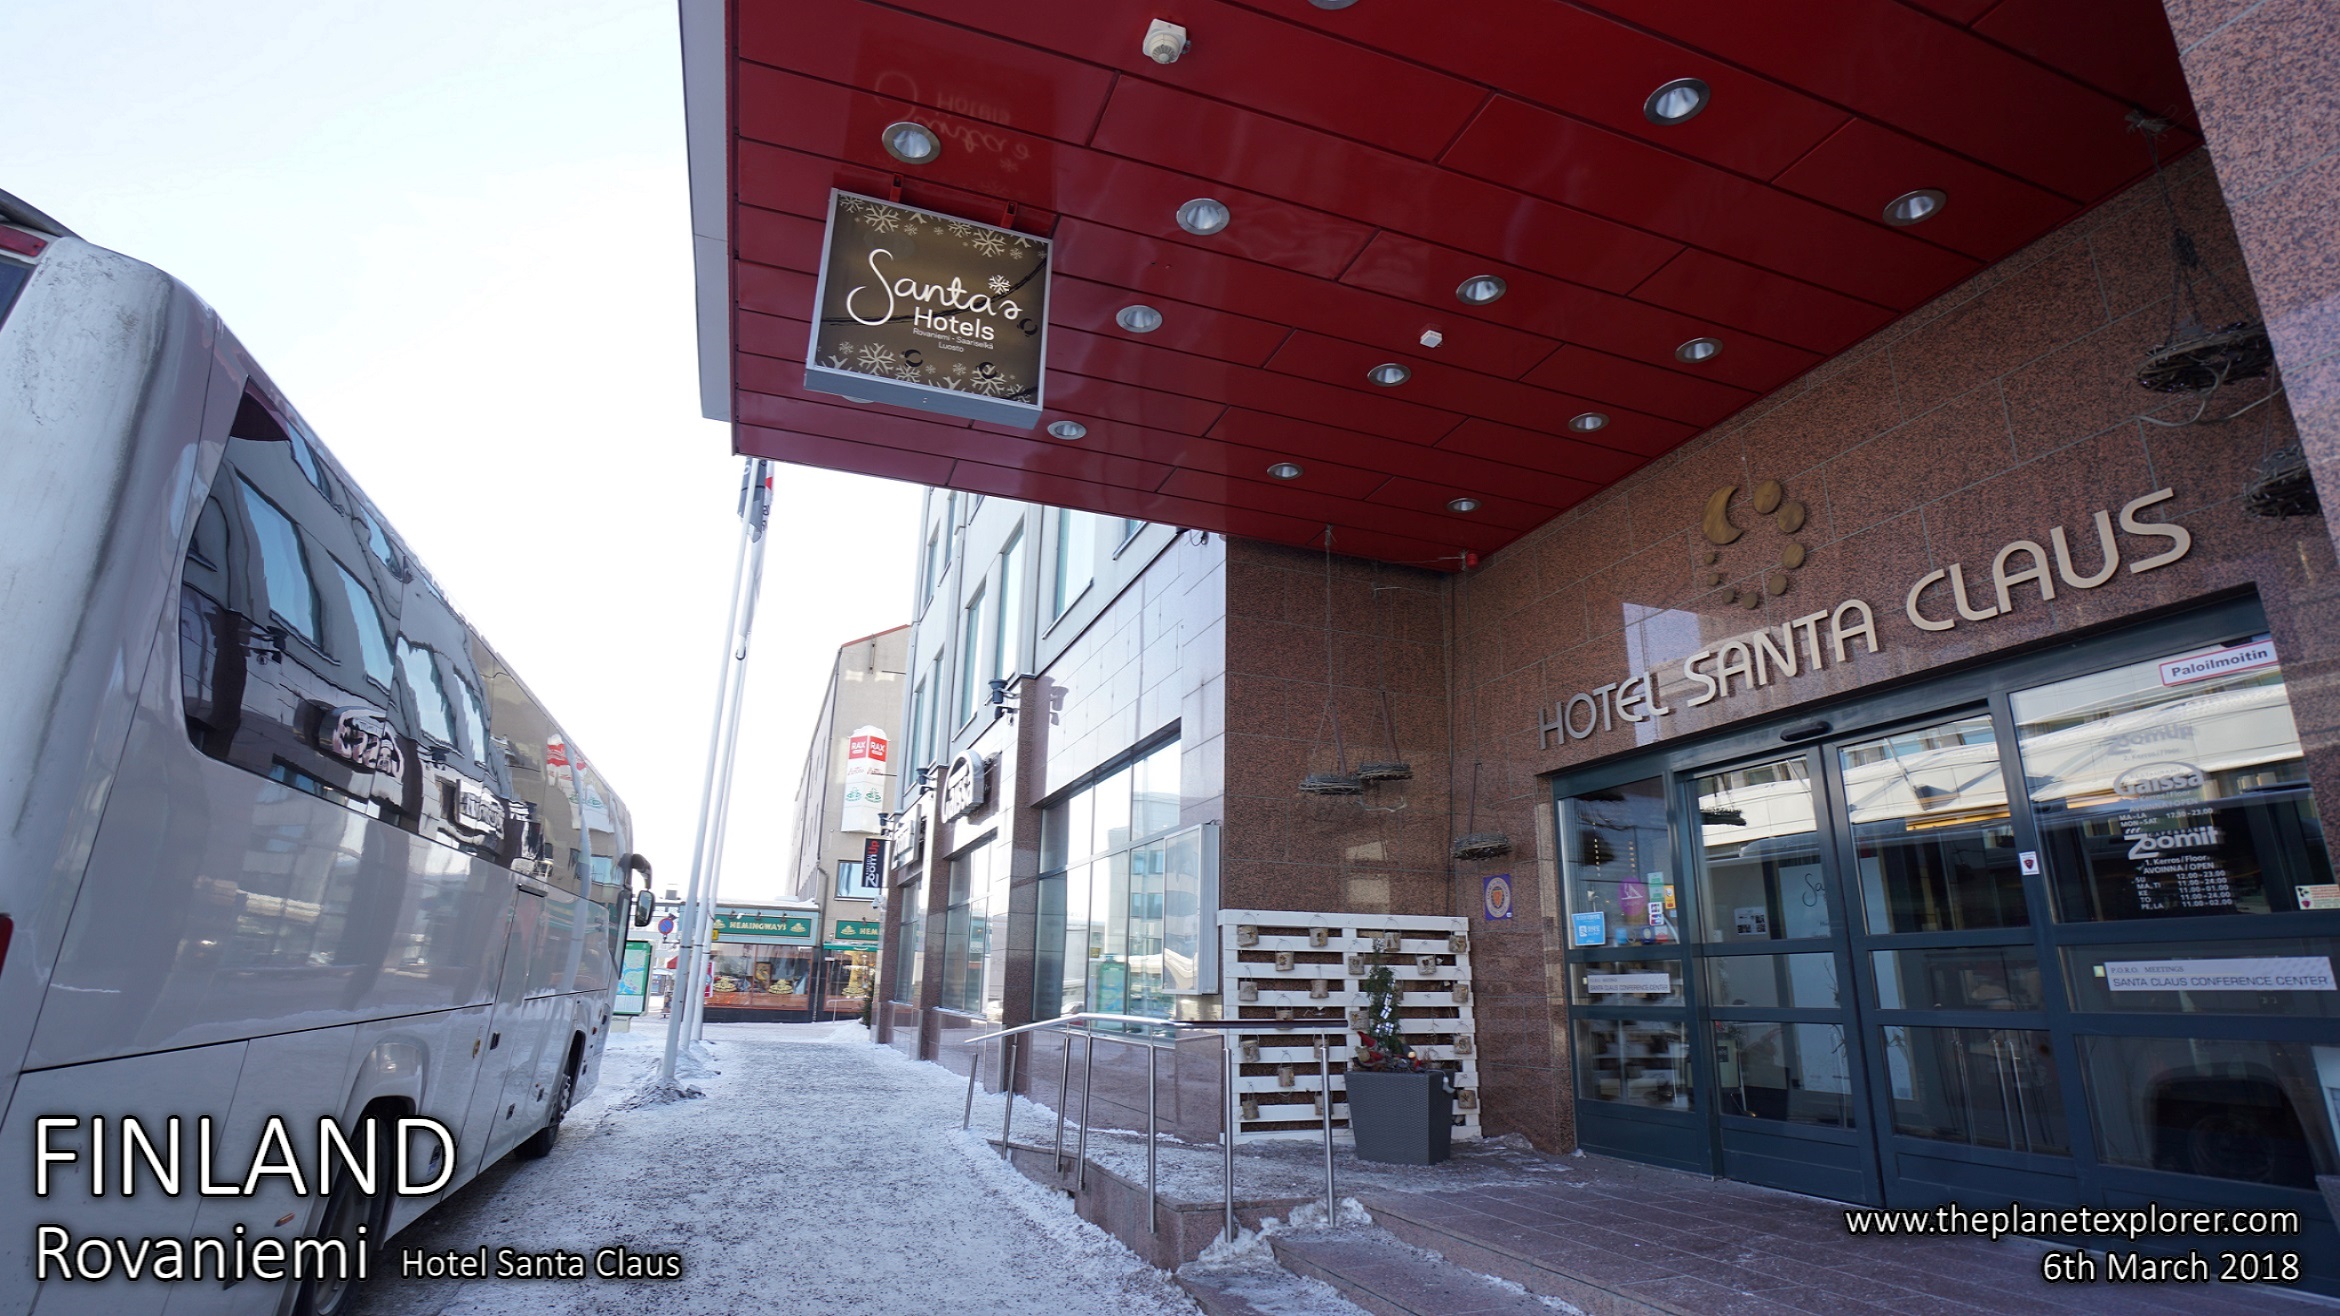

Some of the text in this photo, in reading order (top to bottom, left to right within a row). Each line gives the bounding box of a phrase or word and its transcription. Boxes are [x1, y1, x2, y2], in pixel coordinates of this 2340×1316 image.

[914, 306, 995, 341] Hotels
[913, 328, 950, 341] Rovaniemi
[956, 336, 994, 350] Saariselkä
[938, 342, 965, 353] Luosto
[1538, 487, 2192, 750] HOTEL SANTA CLAUS
[2171, 650, 2268, 677] Paloilmoitin
[851, 741, 866, 749] RAX
[870, 741, 885, 751] RAX
[2114, 770, 2203, 797] Gaissa
[2124, 826, 2218, 860] Zoomit
[2143, 865, 2183, 874] AVOINNA
[2188, 862, 2215, 870] OPEN
[729, 921, 787, 931] HEMINGWAYS
[2113, 975, 2328, 987] SANTA CLAUS CONFERENCE CENTER
